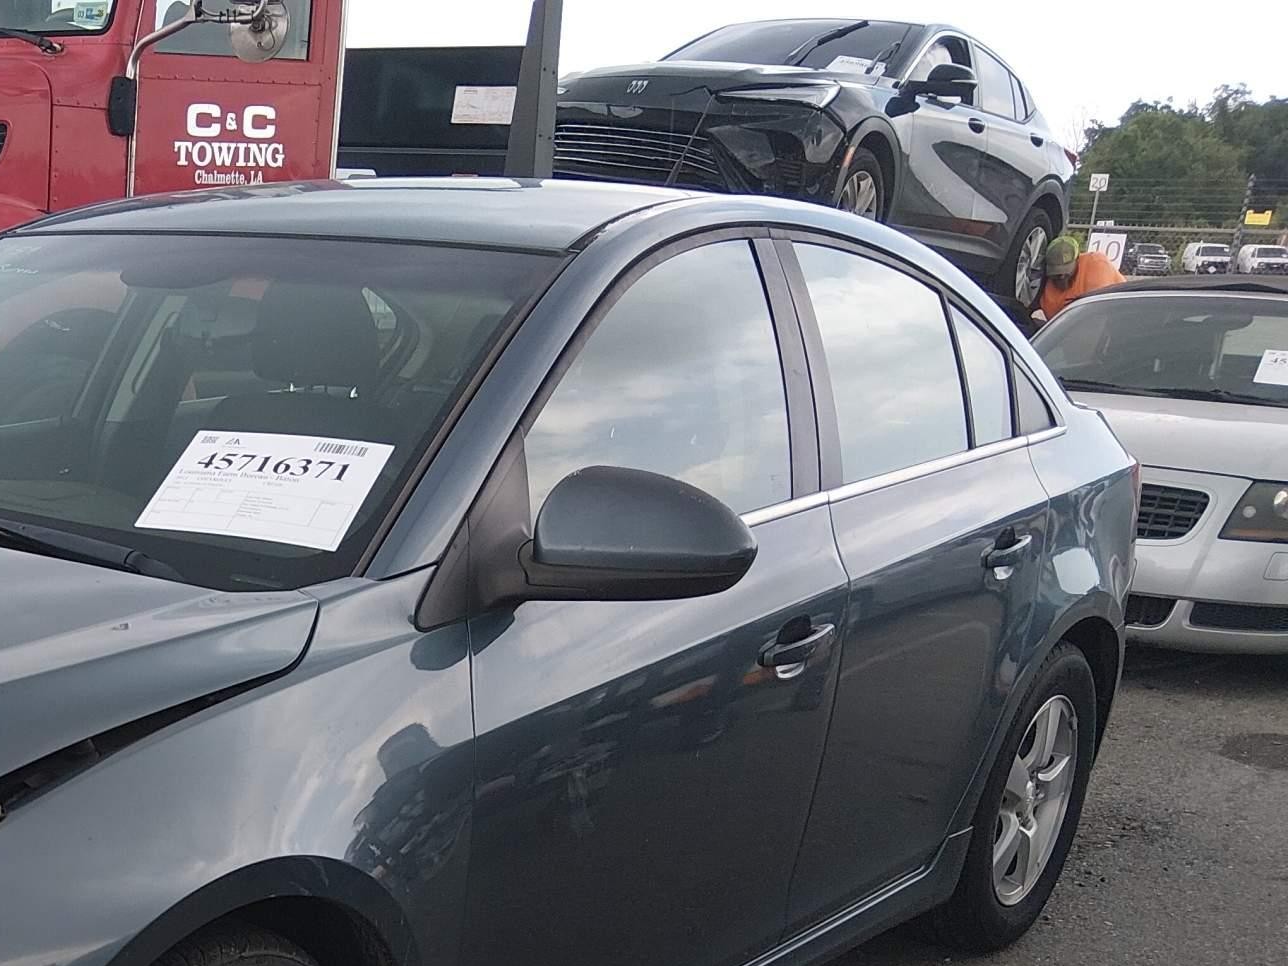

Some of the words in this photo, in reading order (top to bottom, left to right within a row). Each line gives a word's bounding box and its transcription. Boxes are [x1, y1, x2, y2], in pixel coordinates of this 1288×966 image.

[186, 103, 221, 137] C
[226, 112, 237, 131] &
[242, 105, 276, 138] C
[174, 141, 285, 167] TOWING
[250, 170, 263, 184] LA
[1091, 177, 1107, 189] 20
[197, 451, 351, 482] 45716371
